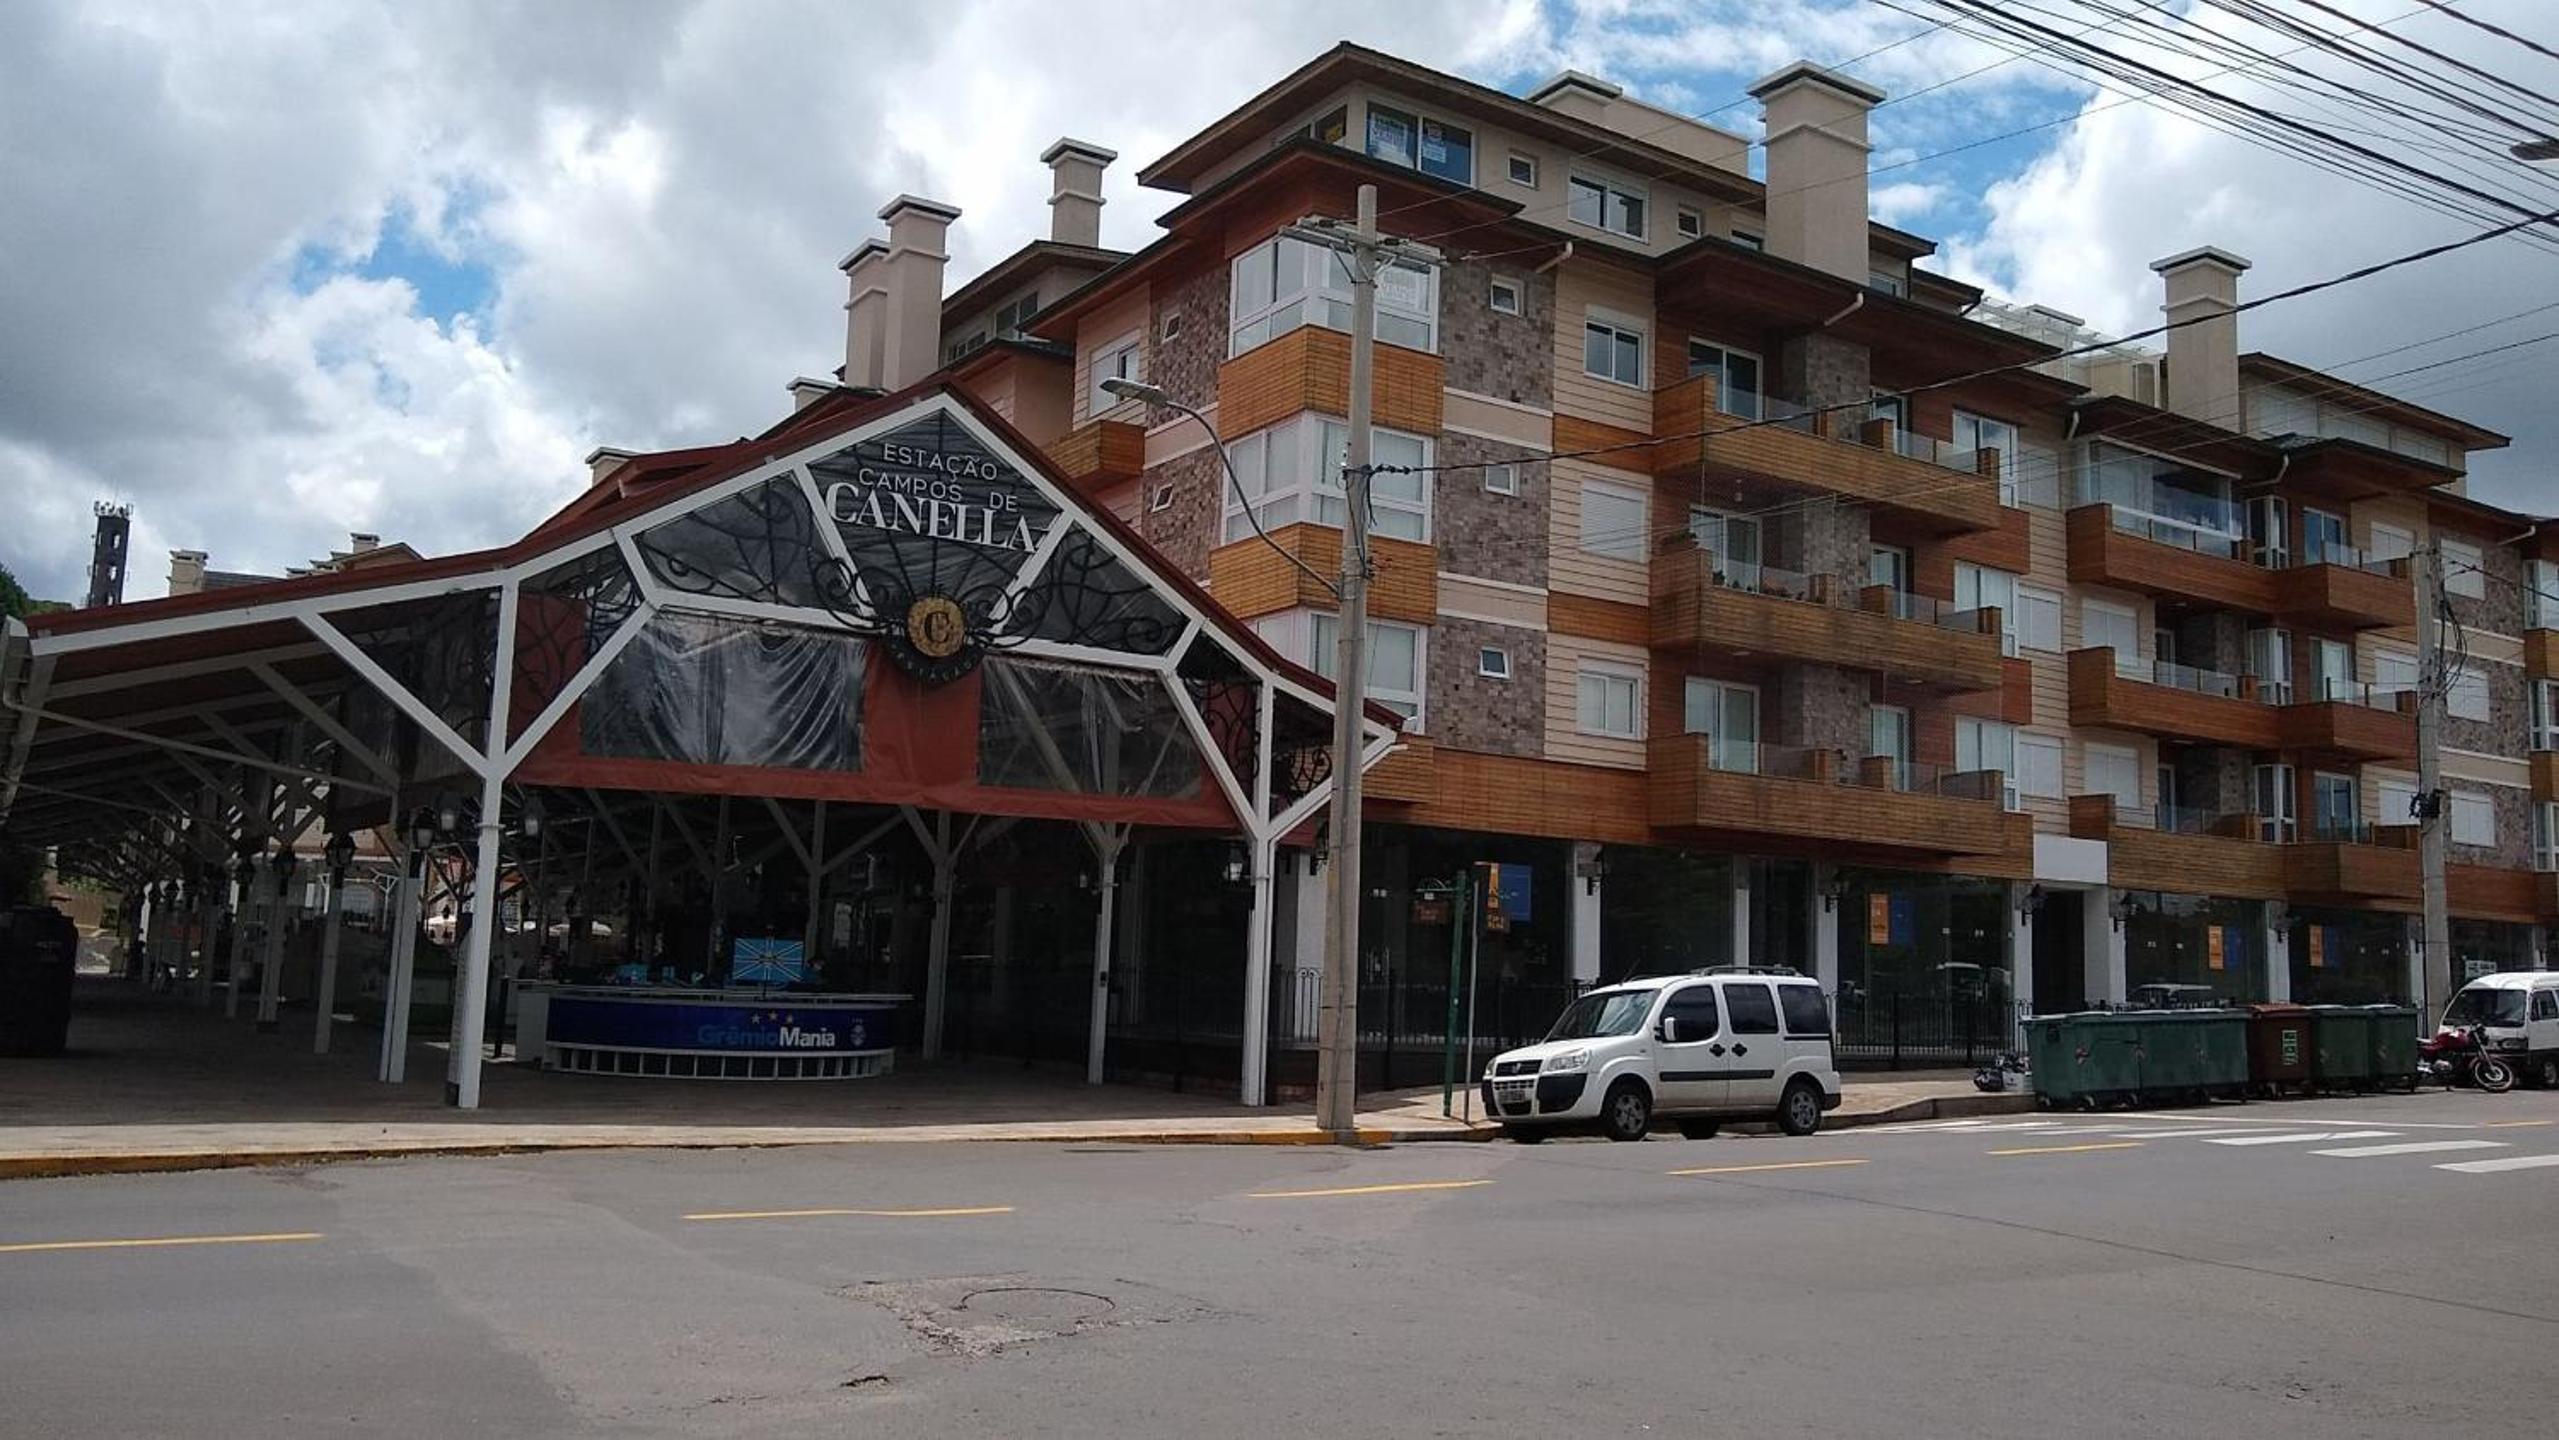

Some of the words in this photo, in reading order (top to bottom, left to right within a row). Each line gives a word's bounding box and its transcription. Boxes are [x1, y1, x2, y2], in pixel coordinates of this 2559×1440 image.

[884, 443, 997, 482] ESTAÇÃO
[859, 468, 963, 502] CAMPOS
[989, 491, 1019, 512] DE
[826, 482, 1037, 553] CANELLA
